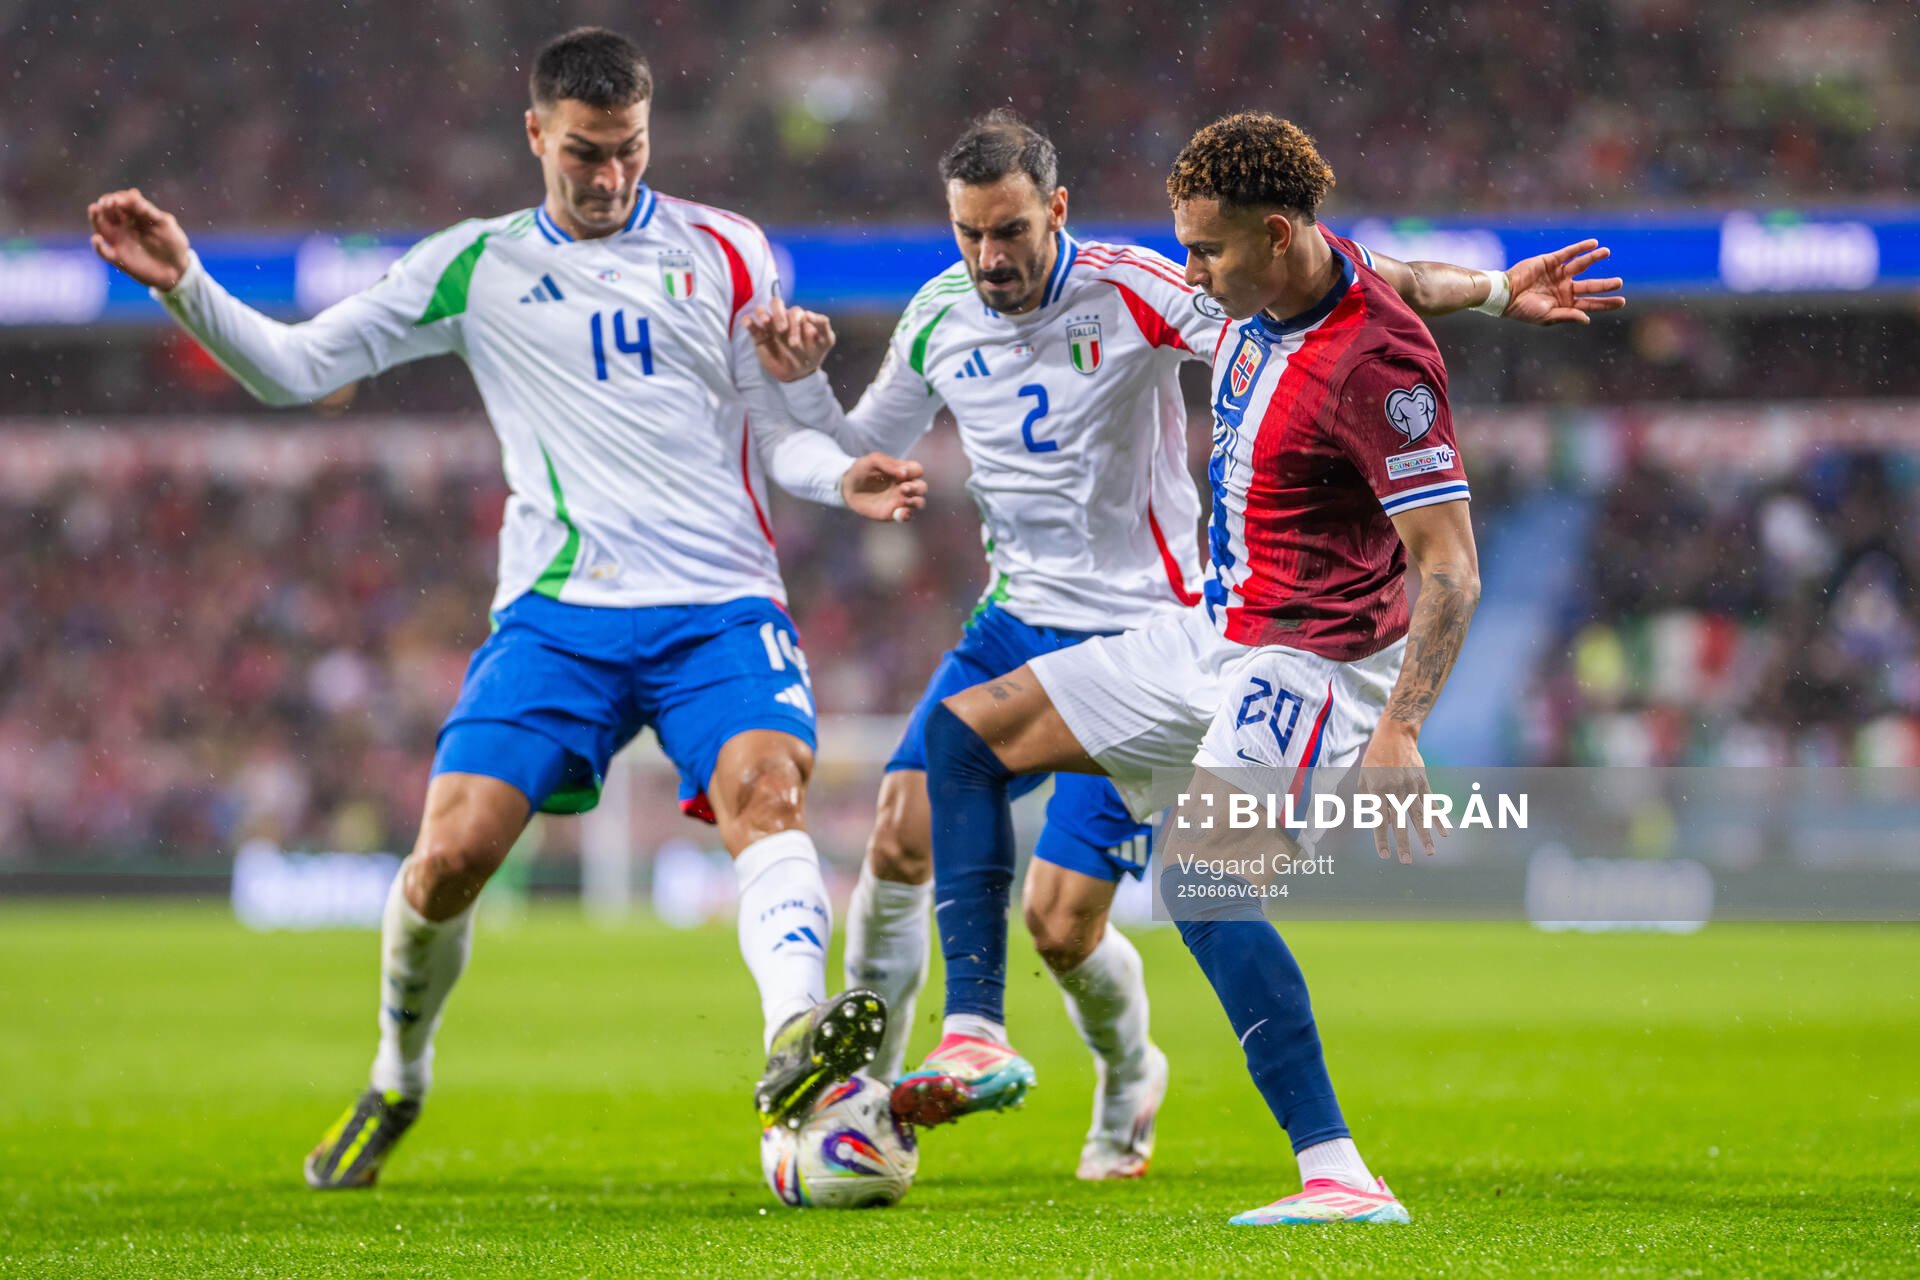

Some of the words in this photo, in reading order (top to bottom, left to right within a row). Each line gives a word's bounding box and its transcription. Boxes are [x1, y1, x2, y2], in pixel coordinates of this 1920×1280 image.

[590, 308, 655, 381] 14
[1070, 326, 1098, 338] ITALIA
[1017, 383, 1060, 453] 2
[1236, 676, 1304, 757] 20
